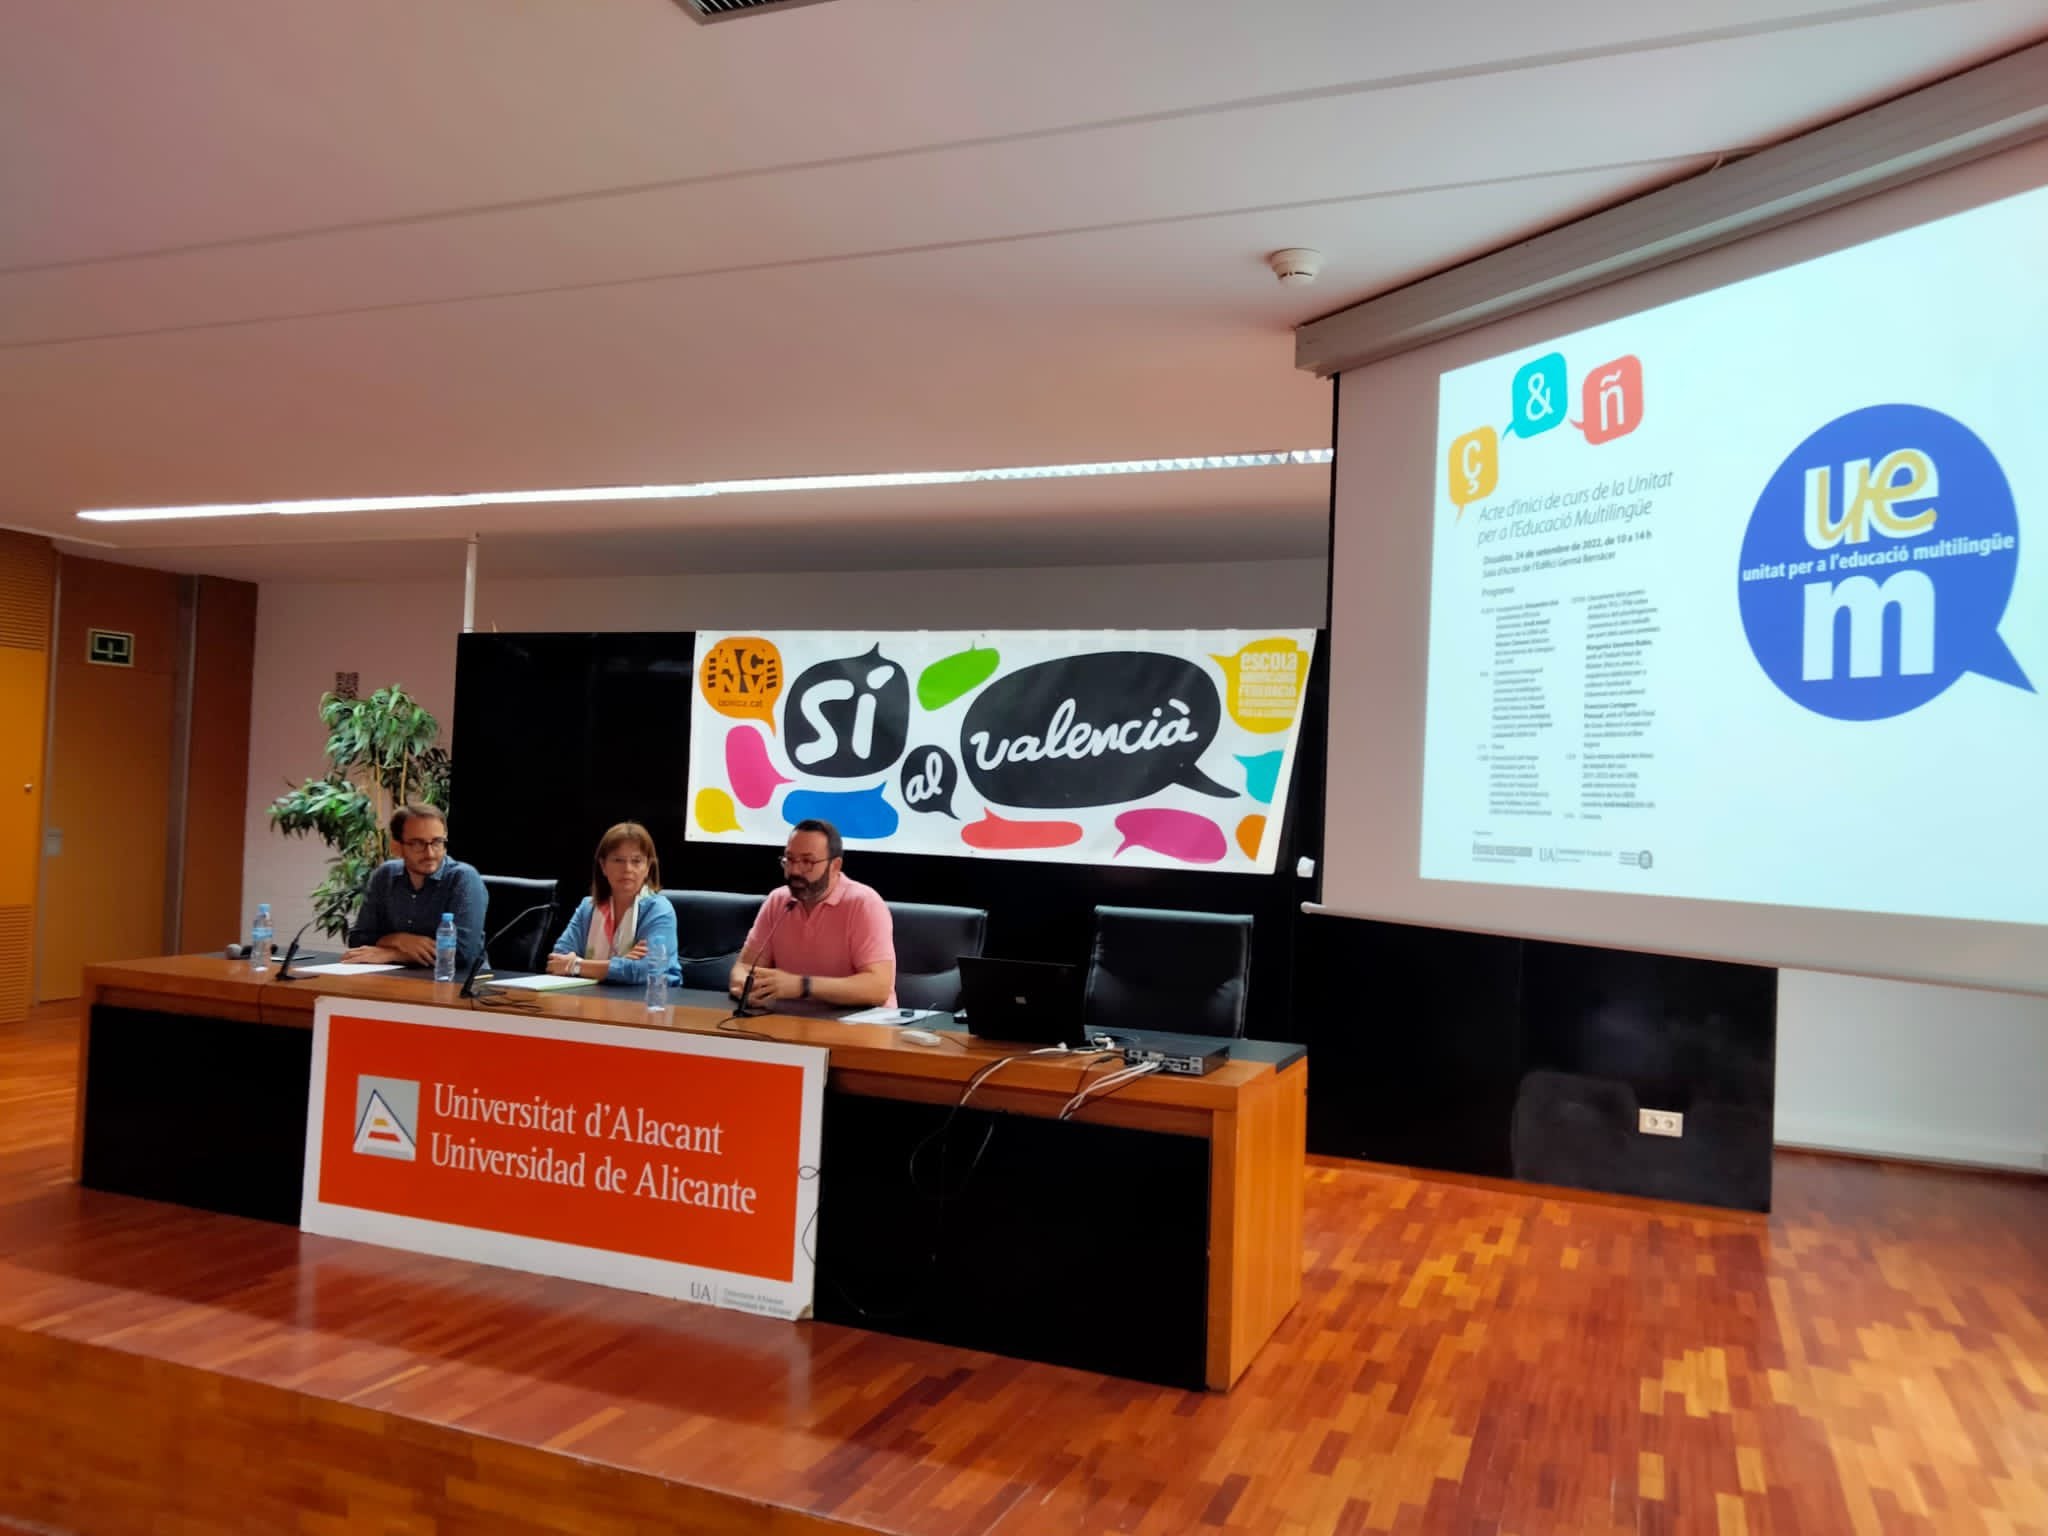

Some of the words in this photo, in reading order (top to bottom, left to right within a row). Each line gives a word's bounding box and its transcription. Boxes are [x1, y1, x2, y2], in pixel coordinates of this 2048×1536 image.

[1600, 370, 1625, 431] ñ
[1479, 504, 1505, 520] Acte
[1506, 496, 1542, 517] d'inici
[1544, 491, 1560, 510] de
[1562, 489, 1589, 506] curs
[1592, 482, 1609, 501] de
[1612, 479, 1625, 496] la
[1627, 470, 1674, 494] Unitat
[1477, 529, 1497, 549] per
[1498, 527, 1507, 541] a
[1510, 513, 1572, 539] l'Educació
[1574, 498, 1653, 527] Multilingüe
[1571, 541, 1580, 551] de
[1604, 536, 1615, 546] de
[1617, 533, 1627, 544] 10
[1635, 530, 1645, 541] 14
[1743, 562, 1785, 582] unitat
[1788, 561, 1813, 579] per
[1816, 559, 1827, 573] a
[1830, 545, 1909, 571] l'educació
[1913, 533, 2015, 560] multilingüe
[1803, 569, 1935, 682] m
[970, 698, 1198, 771] valencià
[905, 751, 943, 804] al
[433, 1082, 577, 1135] Universitat
[585, 1102, 725, 1155] d'Alacant
[431, 1131, 587, 1188] Universidad
[594, 1154, 628, 1194] de
[633, 1161, 757, 1214] Alicante
[690, 1281, 711, 1302] UA
